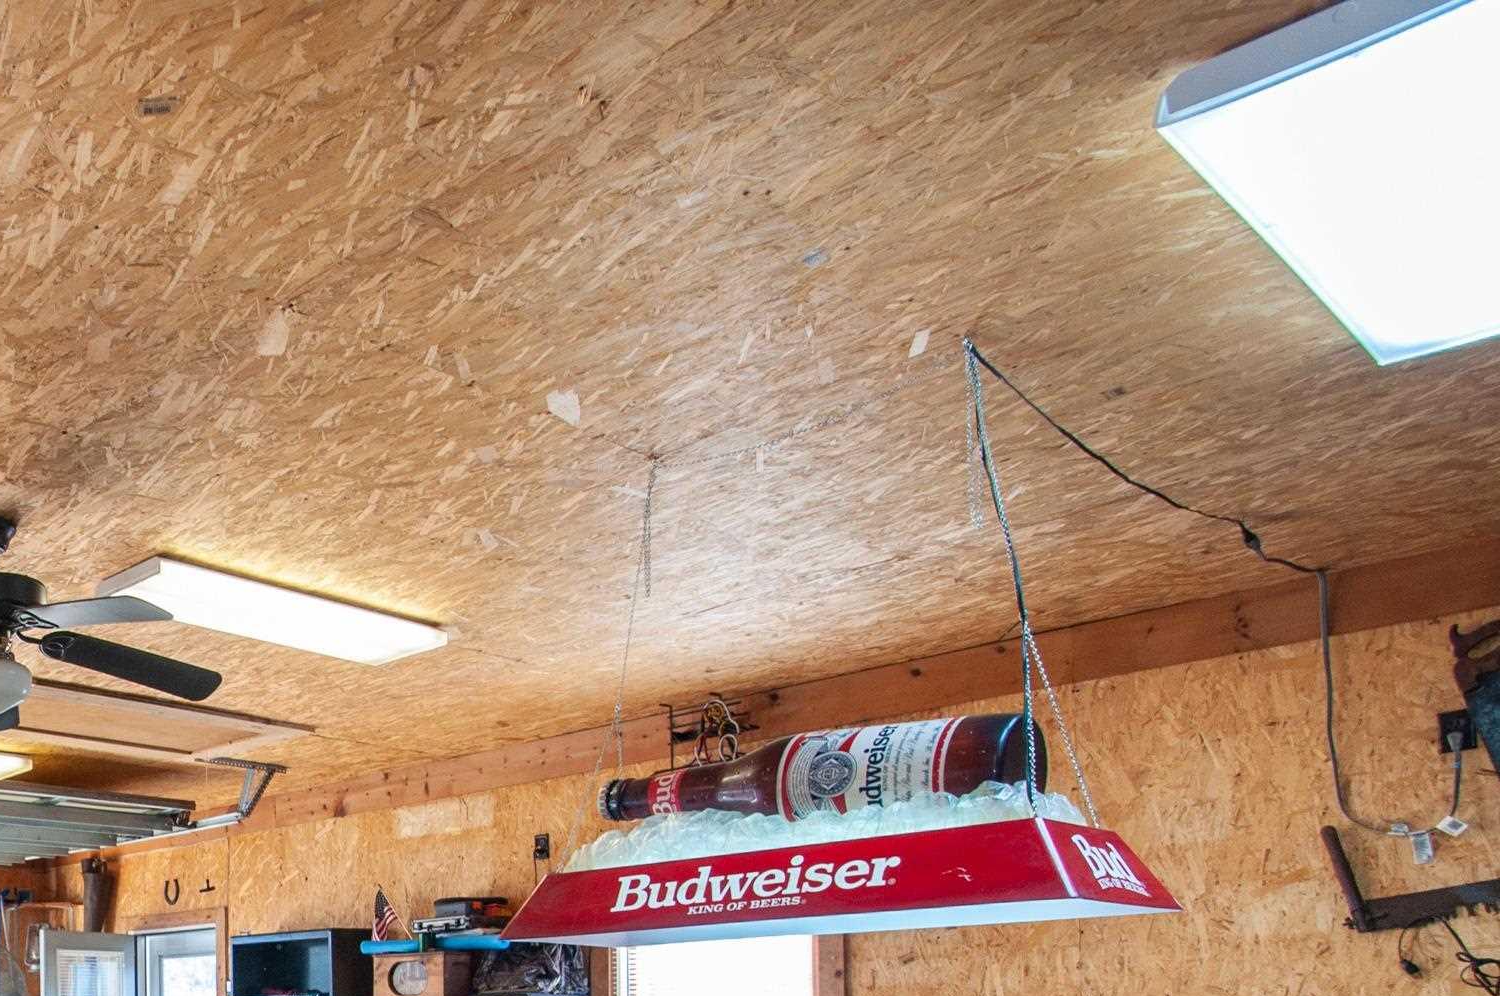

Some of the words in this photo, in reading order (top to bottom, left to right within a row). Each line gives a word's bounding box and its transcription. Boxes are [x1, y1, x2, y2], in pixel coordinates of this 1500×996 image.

[610, 855, 901, 913] Budweiser
[1071, 834, 1147, 888] Bud
[687, 903, 726, 916] KING
[727, 901, 747, 911] OF
[750, 896, 801, 910] BEERS
